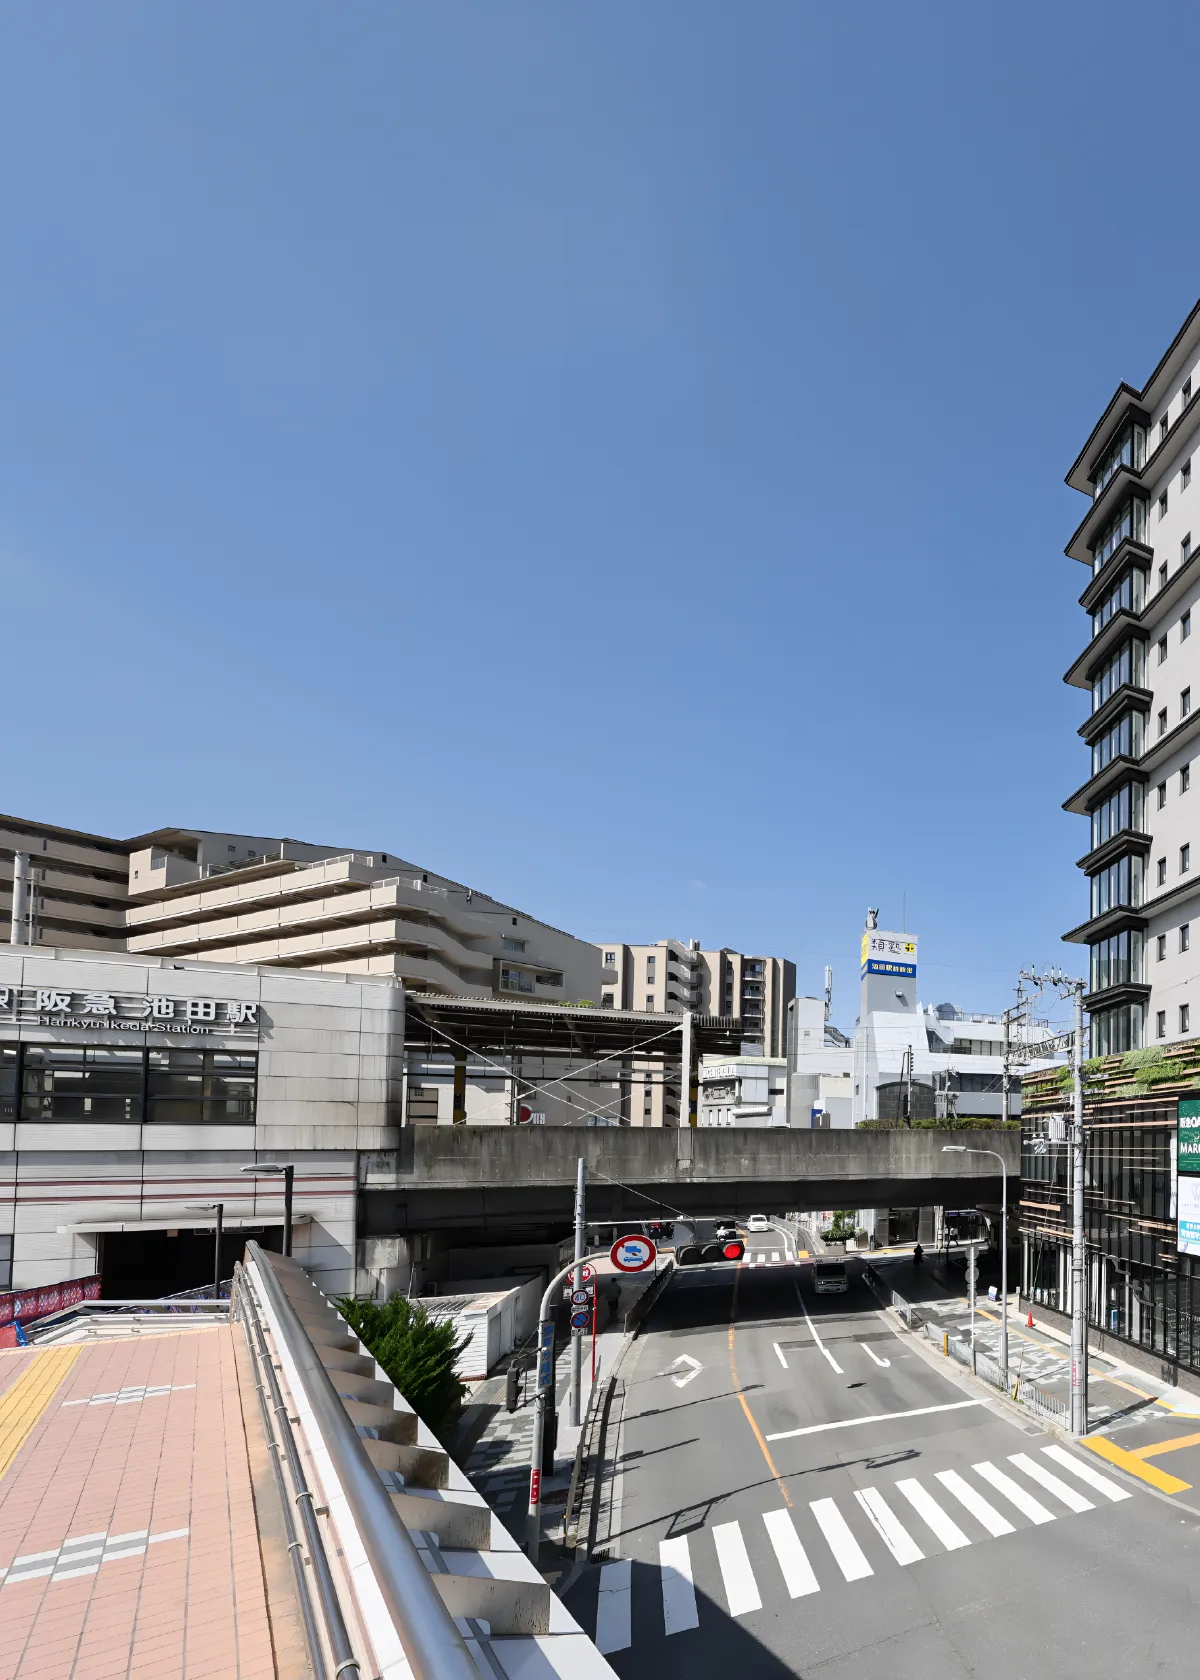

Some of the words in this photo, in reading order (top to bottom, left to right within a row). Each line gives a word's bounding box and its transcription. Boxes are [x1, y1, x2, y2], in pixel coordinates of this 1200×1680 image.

[37, 989, 117, 1015] 阪急
[141, 996, 257, 1024] 池田駅
[37, 1015, 105, 1030] Hankyu
[106, 1020, 149, 1032] Ikeda
[156, 1021, 209, 1035] Station
